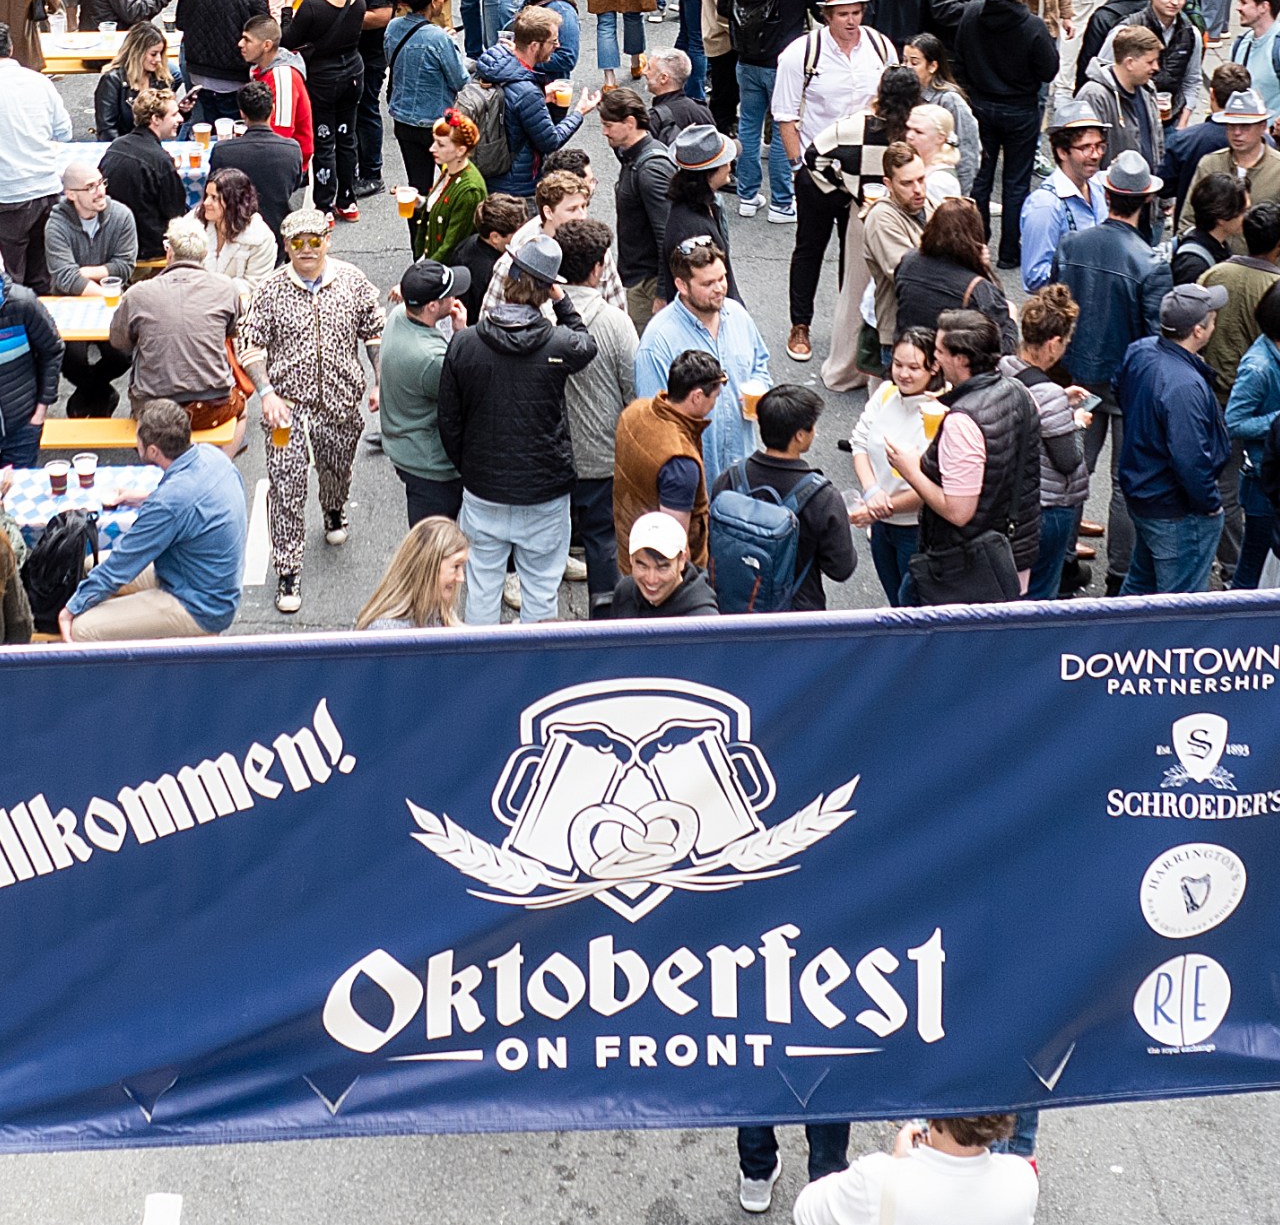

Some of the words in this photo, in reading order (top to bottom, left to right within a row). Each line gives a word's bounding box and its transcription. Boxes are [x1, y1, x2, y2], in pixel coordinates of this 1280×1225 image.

[1061, 645, 1279, 680] DOWNTOWN
[1107, 674, 1275, 695] PARTNERSHIP
[1226, 744, 1250, 756] 1893
[1149, 849, 1241, 890] HARRINGTON'S
[323, 924, 945, 1053] Oktoberfest
[496, 1037, 568, 1070] ON
[596, 1034, 772, 1067] FRONT
[1147, 1046, 1160, 1055] the
[1161, 1046, 1180, 1054] royal
[1181, 1044, 1216, 1054] exchange
